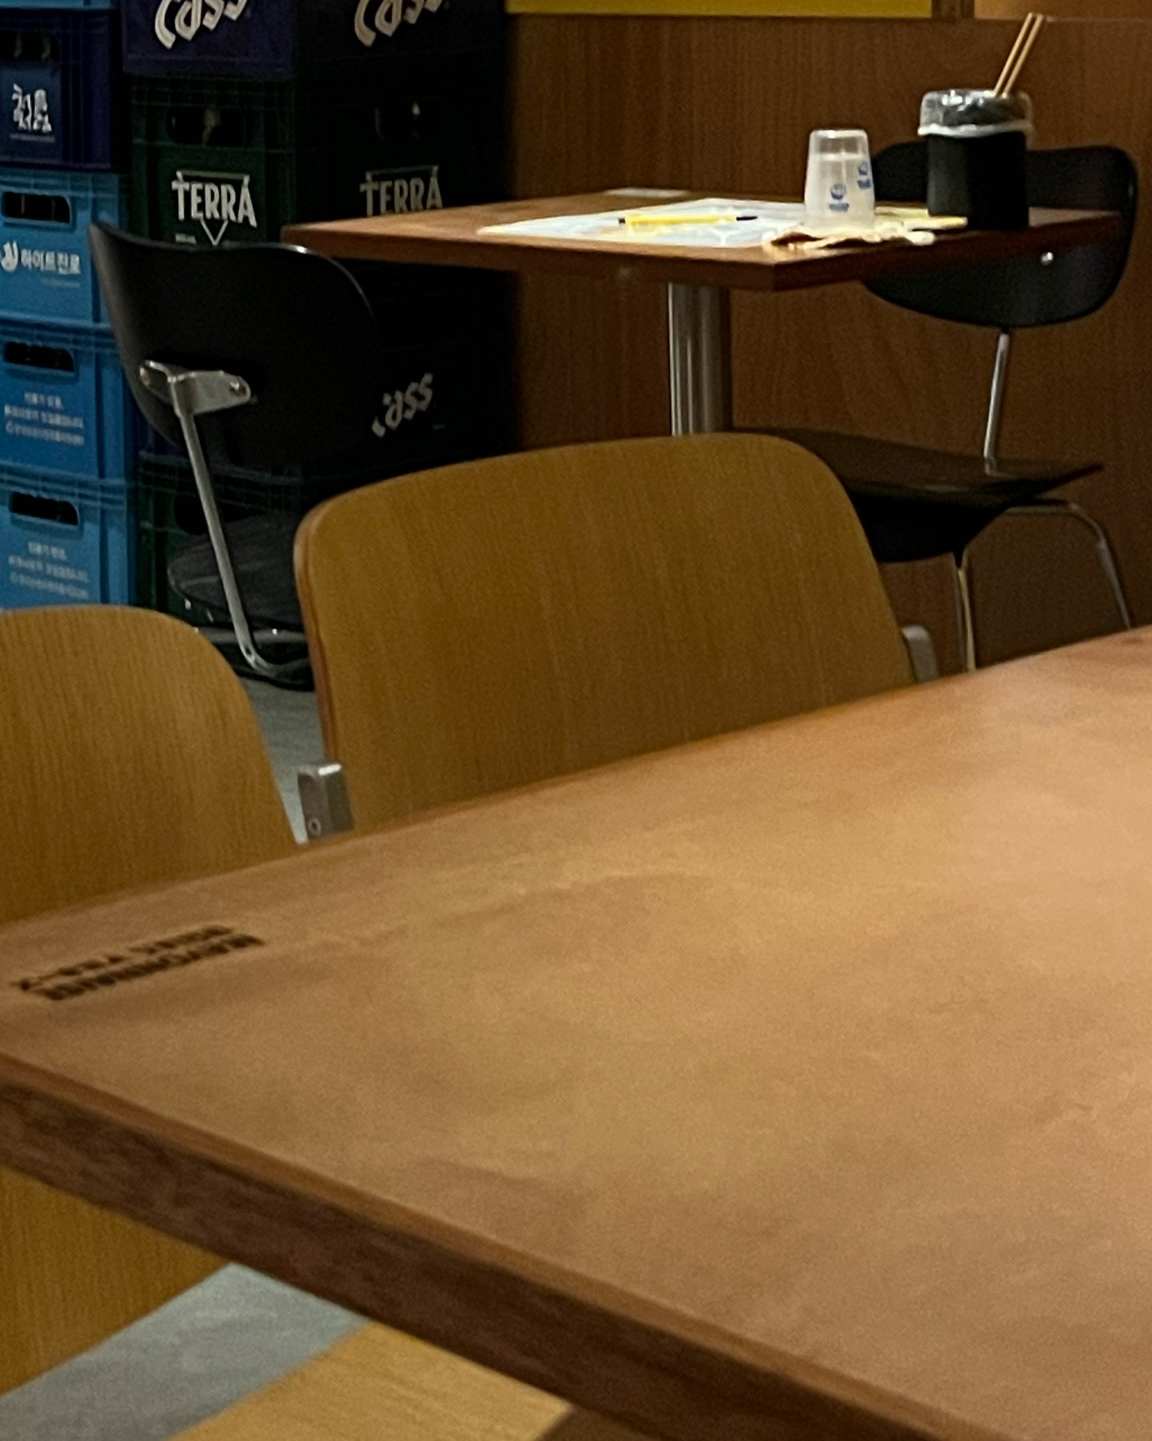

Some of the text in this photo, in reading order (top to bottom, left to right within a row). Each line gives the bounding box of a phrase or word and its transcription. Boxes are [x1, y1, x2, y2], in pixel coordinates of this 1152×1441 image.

[171, 174, 257, 228] TERRA
[359, 170, 444, 217] TERRA
[20, 248, 81, 275] 하이트진로
